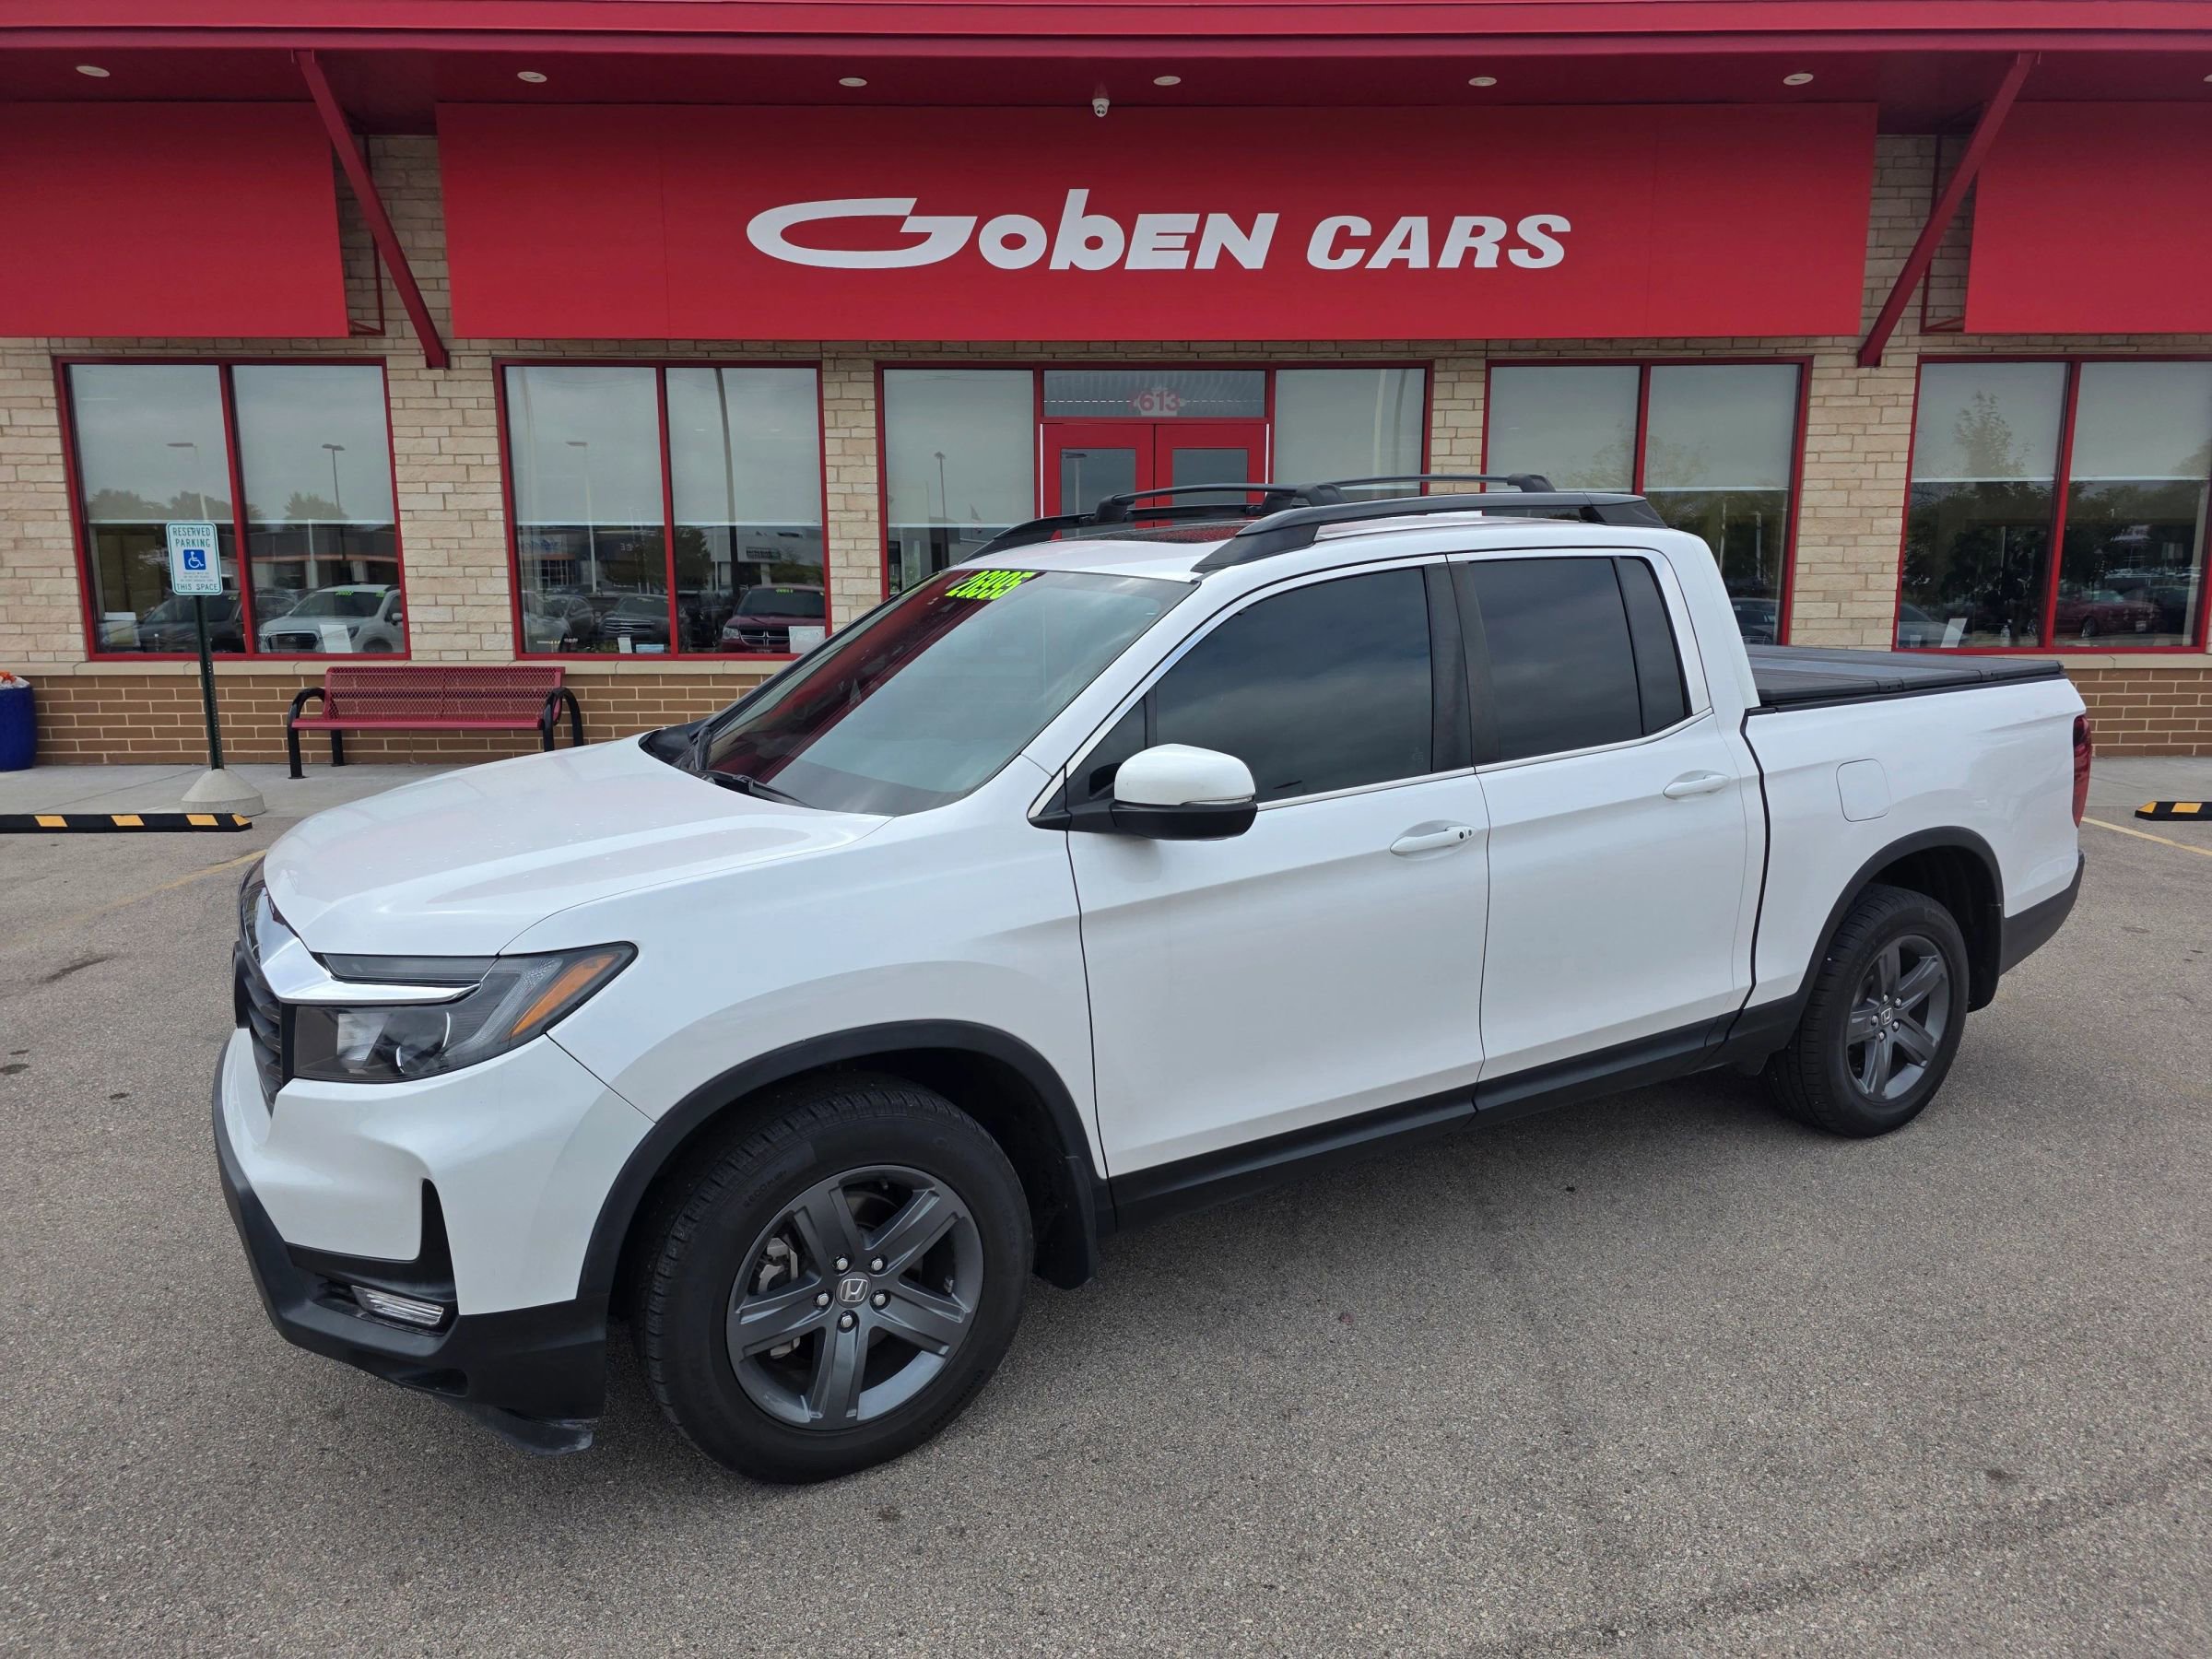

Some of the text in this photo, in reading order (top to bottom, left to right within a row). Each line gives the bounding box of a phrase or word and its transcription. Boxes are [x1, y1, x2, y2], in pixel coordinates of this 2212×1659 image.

[1306, 215, 1571, 269] CARS
[1139, 391, 1180, 411] 613
[172, 527, 211, 536] RESERVED
[175, 538, 211, 547] PARKING
